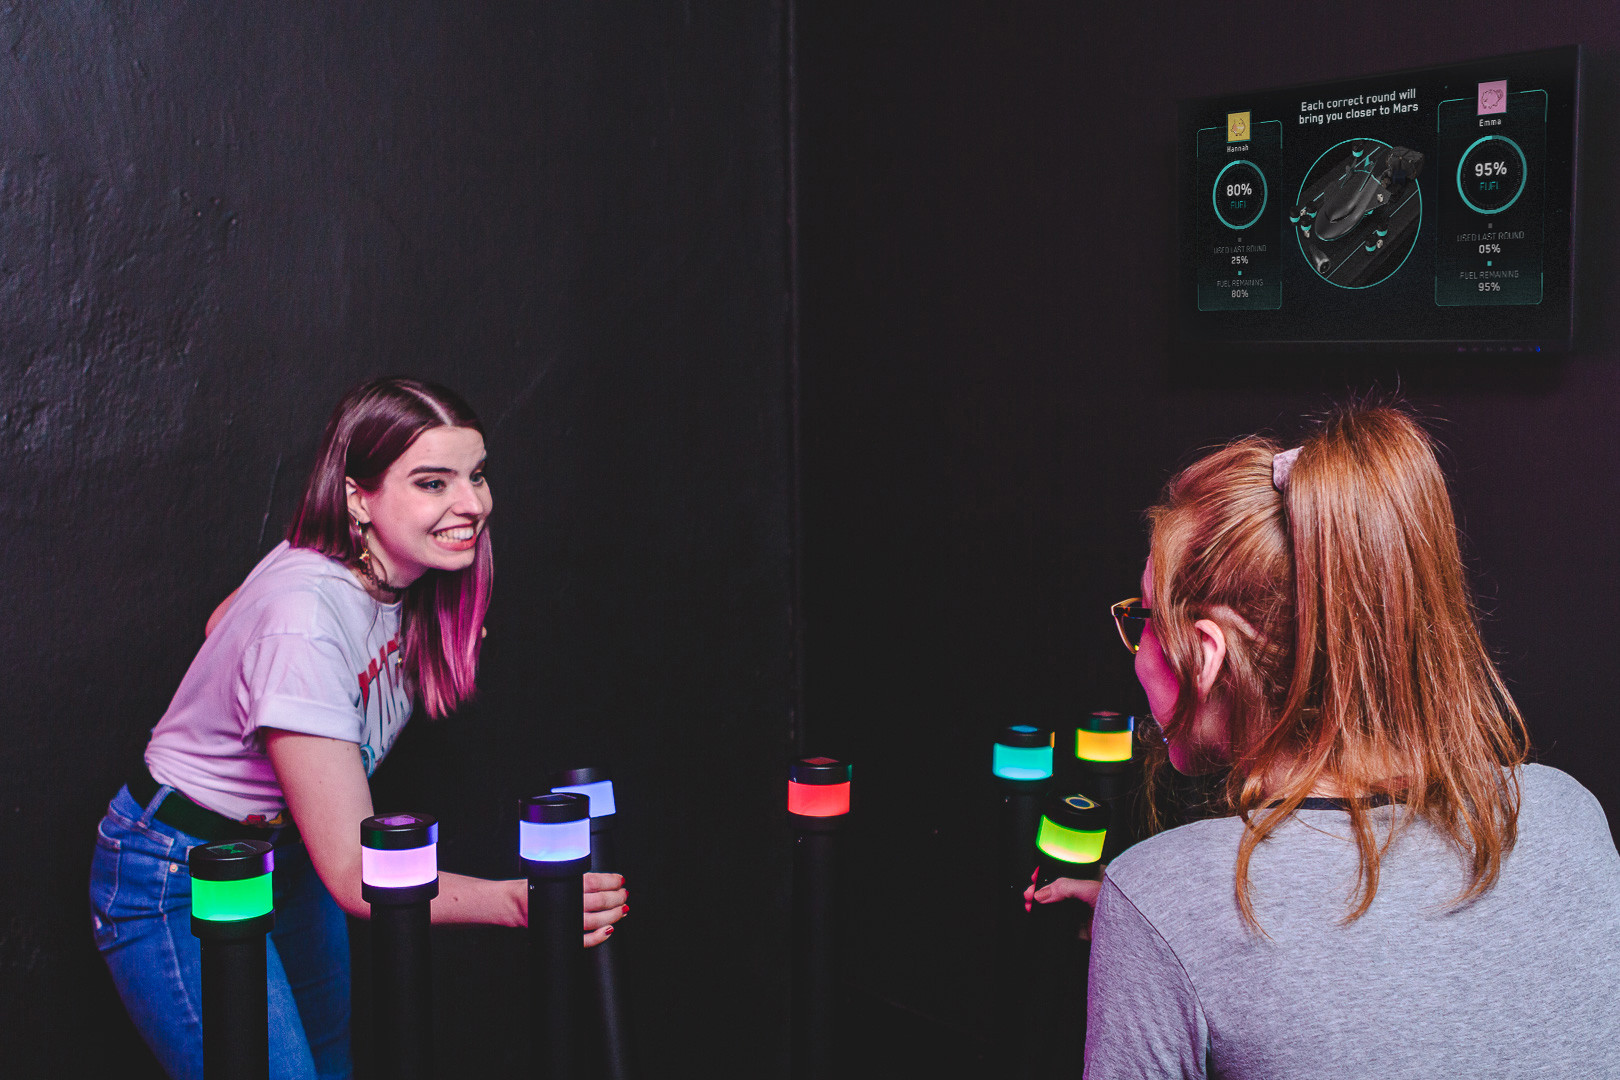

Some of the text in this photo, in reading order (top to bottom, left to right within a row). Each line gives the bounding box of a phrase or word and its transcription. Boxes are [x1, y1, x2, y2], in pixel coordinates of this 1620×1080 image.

[1301, 88, 1416, 112] Each correct round will
[1299, 103, 1419, 125] bring you closer to Mars
[1479, 119, 1502, 127] Emma
[1226, 144, 1249, 153] Hannah
[1474, 161, 1508, 177] 95%
[1226, 183, 1253, 197] 80%
[1498, 230, 1525, 240] ROUND
[1478, 243, 1501, 254] 05%
[1231, 255, 1249, 265] 25%
[1460, 269, 1520, 280] FUEL REMAINING
[1216, 280, 1231, 288] FUEL
[1478, 281, 1501, 292] 95%
[1231, 289, 1249, 298] 80%
